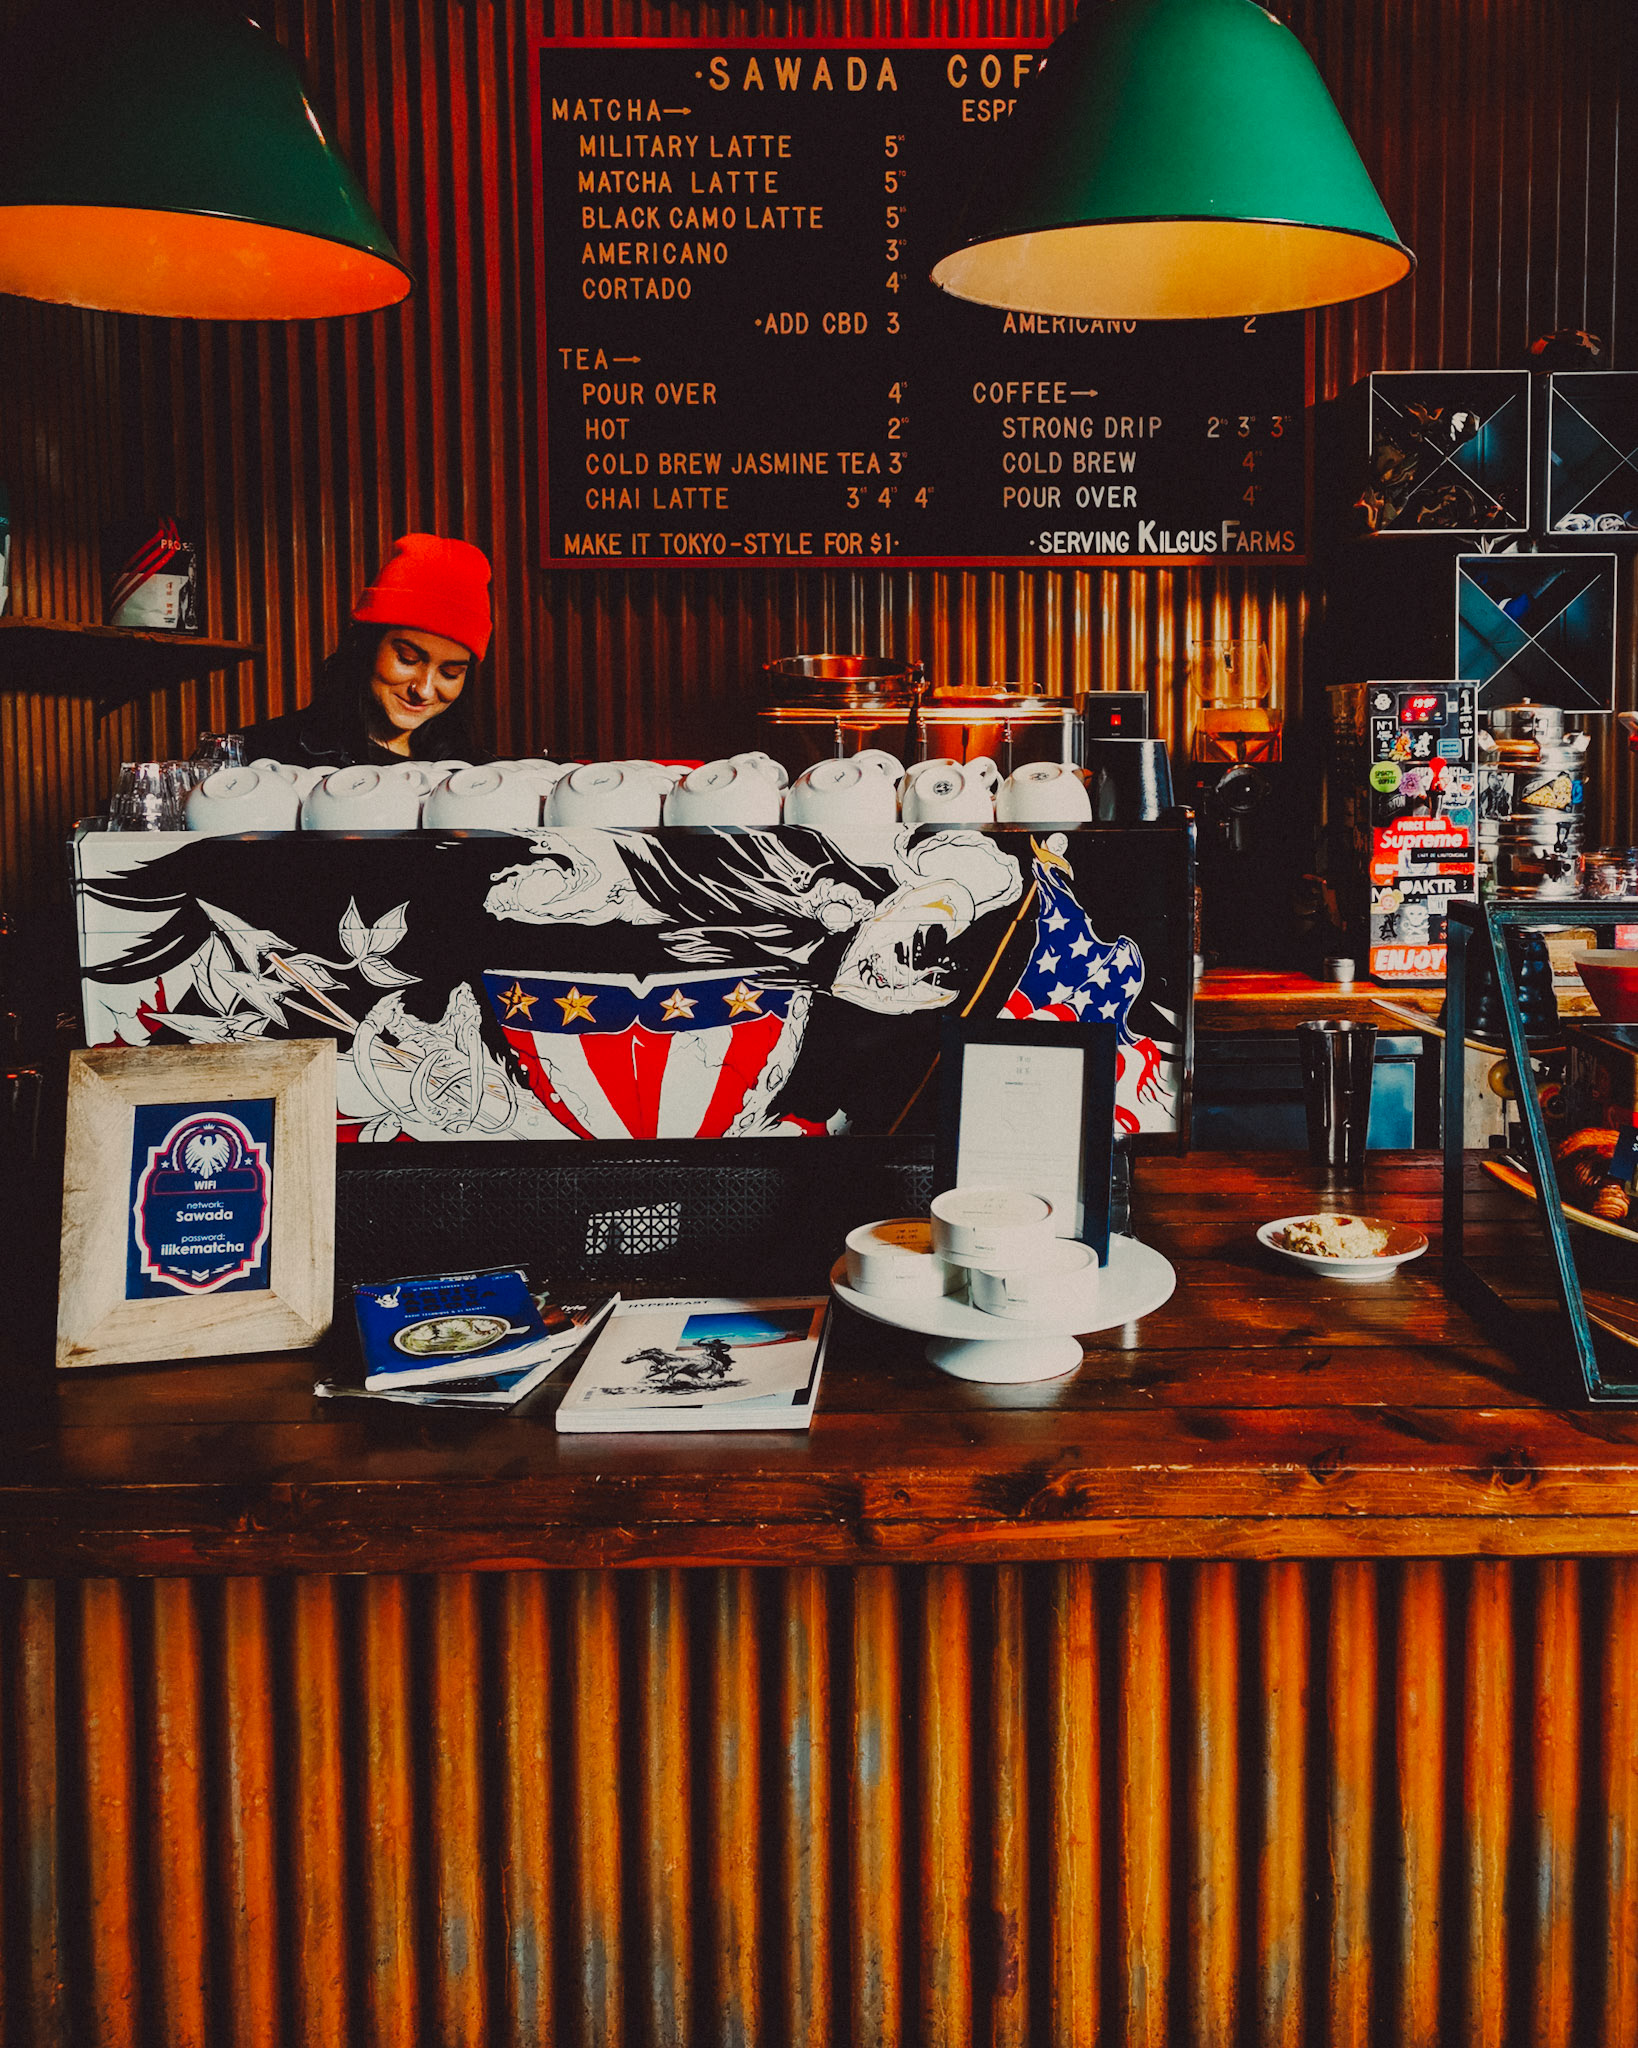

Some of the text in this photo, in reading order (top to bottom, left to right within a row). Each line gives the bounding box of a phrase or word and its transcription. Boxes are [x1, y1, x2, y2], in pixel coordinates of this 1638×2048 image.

[709, 56, 897, 91] SAWADA
[552, 98, 661, 121] MATCHA
[580, 135, 698, 158] MILITARY
[710, 135, 791, 157] LATTE
[579, 171, 672, 193] MATCHA
[692, 171, 778, 193] LATTE
[582, 206, 660, 229] BLACK
[669, 207, 736, 229] CAMO
[746, 207, 823, 229] LATTE
[582, 242, 727, 264] AMERICANO
[583, 278, 691, 299] CORTADO
[765, 312, 900, 334] ADD CBD 3
[559, 348, 608, 370] TEA
[583, 383, 643, 405] POUR
[655, 383, 716, 404] OVER
[973, 382, 1066, 403] COFFEE
[586, 418, 629, 440] HOT
[1003, 417, 1093, 438] STRONG
[1105, 417, 1161, 438] DRIP
[586, 453, 648, 475] COLD
[659, 453, 721, 474] BREW
[732, 452, 828, 474] JASMINE
[837, 452, 880, 474] TEA
[1003, 452, 1062, 473] COLD
[1074, 452, 1136, 473] BREW
[586, 488, 639, 509] CHAI
[654, 488, 728, 509] LATTE
[1004, 487, 1060, 508] POUR
[1076, 486, 1136, 508] OVER
[565, 533, 622, 555] MAKE
[632, 533, 650, 555] IT
[660, 533, 812, 555] TOKYO-STYLE
[825, 533, 863, 554] FOR
[1039, 520, 1295, 553] SERVING KILGUS FARMS
[1380, 830, 1464, 851] Supreme
[1375, 949, 1447, 971] ENJOY
[194, 1180, 217, 1190] WIFI
[176, 1209, 233, 1222] Sawada
[187, 1201, 224, 1210] network:
[161, 1242, 244, 1256] ilikematcha
[181, 1233, 226, 1243] password:
[628, 1300, 710, 1309] HYPEBEAST
